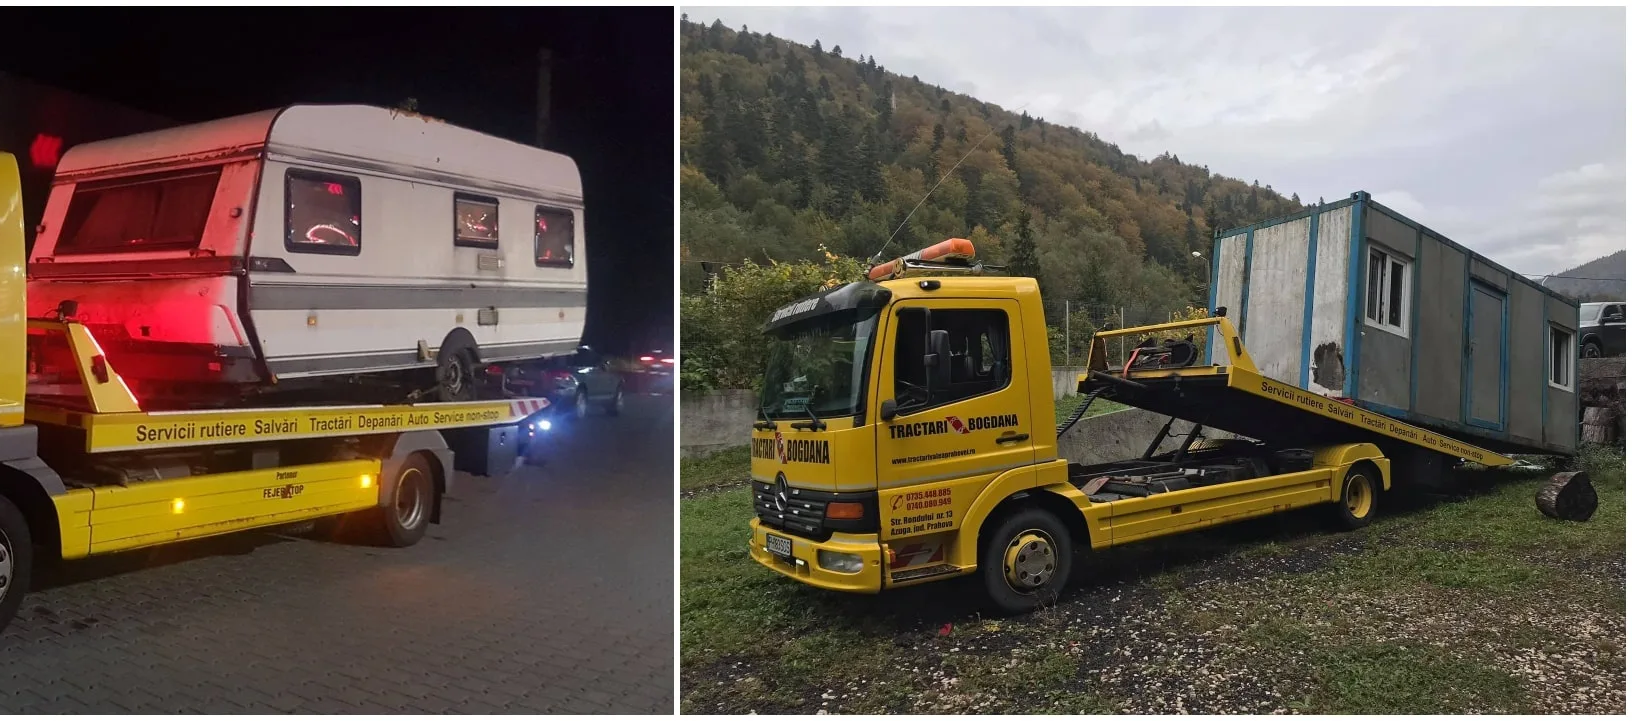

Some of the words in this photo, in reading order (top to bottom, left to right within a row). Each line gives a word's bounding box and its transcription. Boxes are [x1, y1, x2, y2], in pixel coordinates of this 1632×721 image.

[136, 423, 195, 442] Servicii
[200, 422, 246, 438] rutiere
[254, 418, 298, 434] Salvări
[309, 416, 352, 432] Tractări
[358, 414, 403, 430] Depanări
[408, 414, 428, 426] Auto
[434, 411, 464, 424] Service
[466, 410, 499, 421] non-stop
[889, 420, 948, 439] TRACTARI
[968, 414, 1018, 430] BOGDANA
[1261, 382, 1294, 400] Servicii
[1296, 395, 1324, 410] rutiere
[1422, 434, 1436, 446] Auto
[1440, 440, 1460, 453] Service
[788, 439, 830, 464] BOGDANA
[927, 520, 953, 530] Prahova
[946, 510, 952, 518] 13
